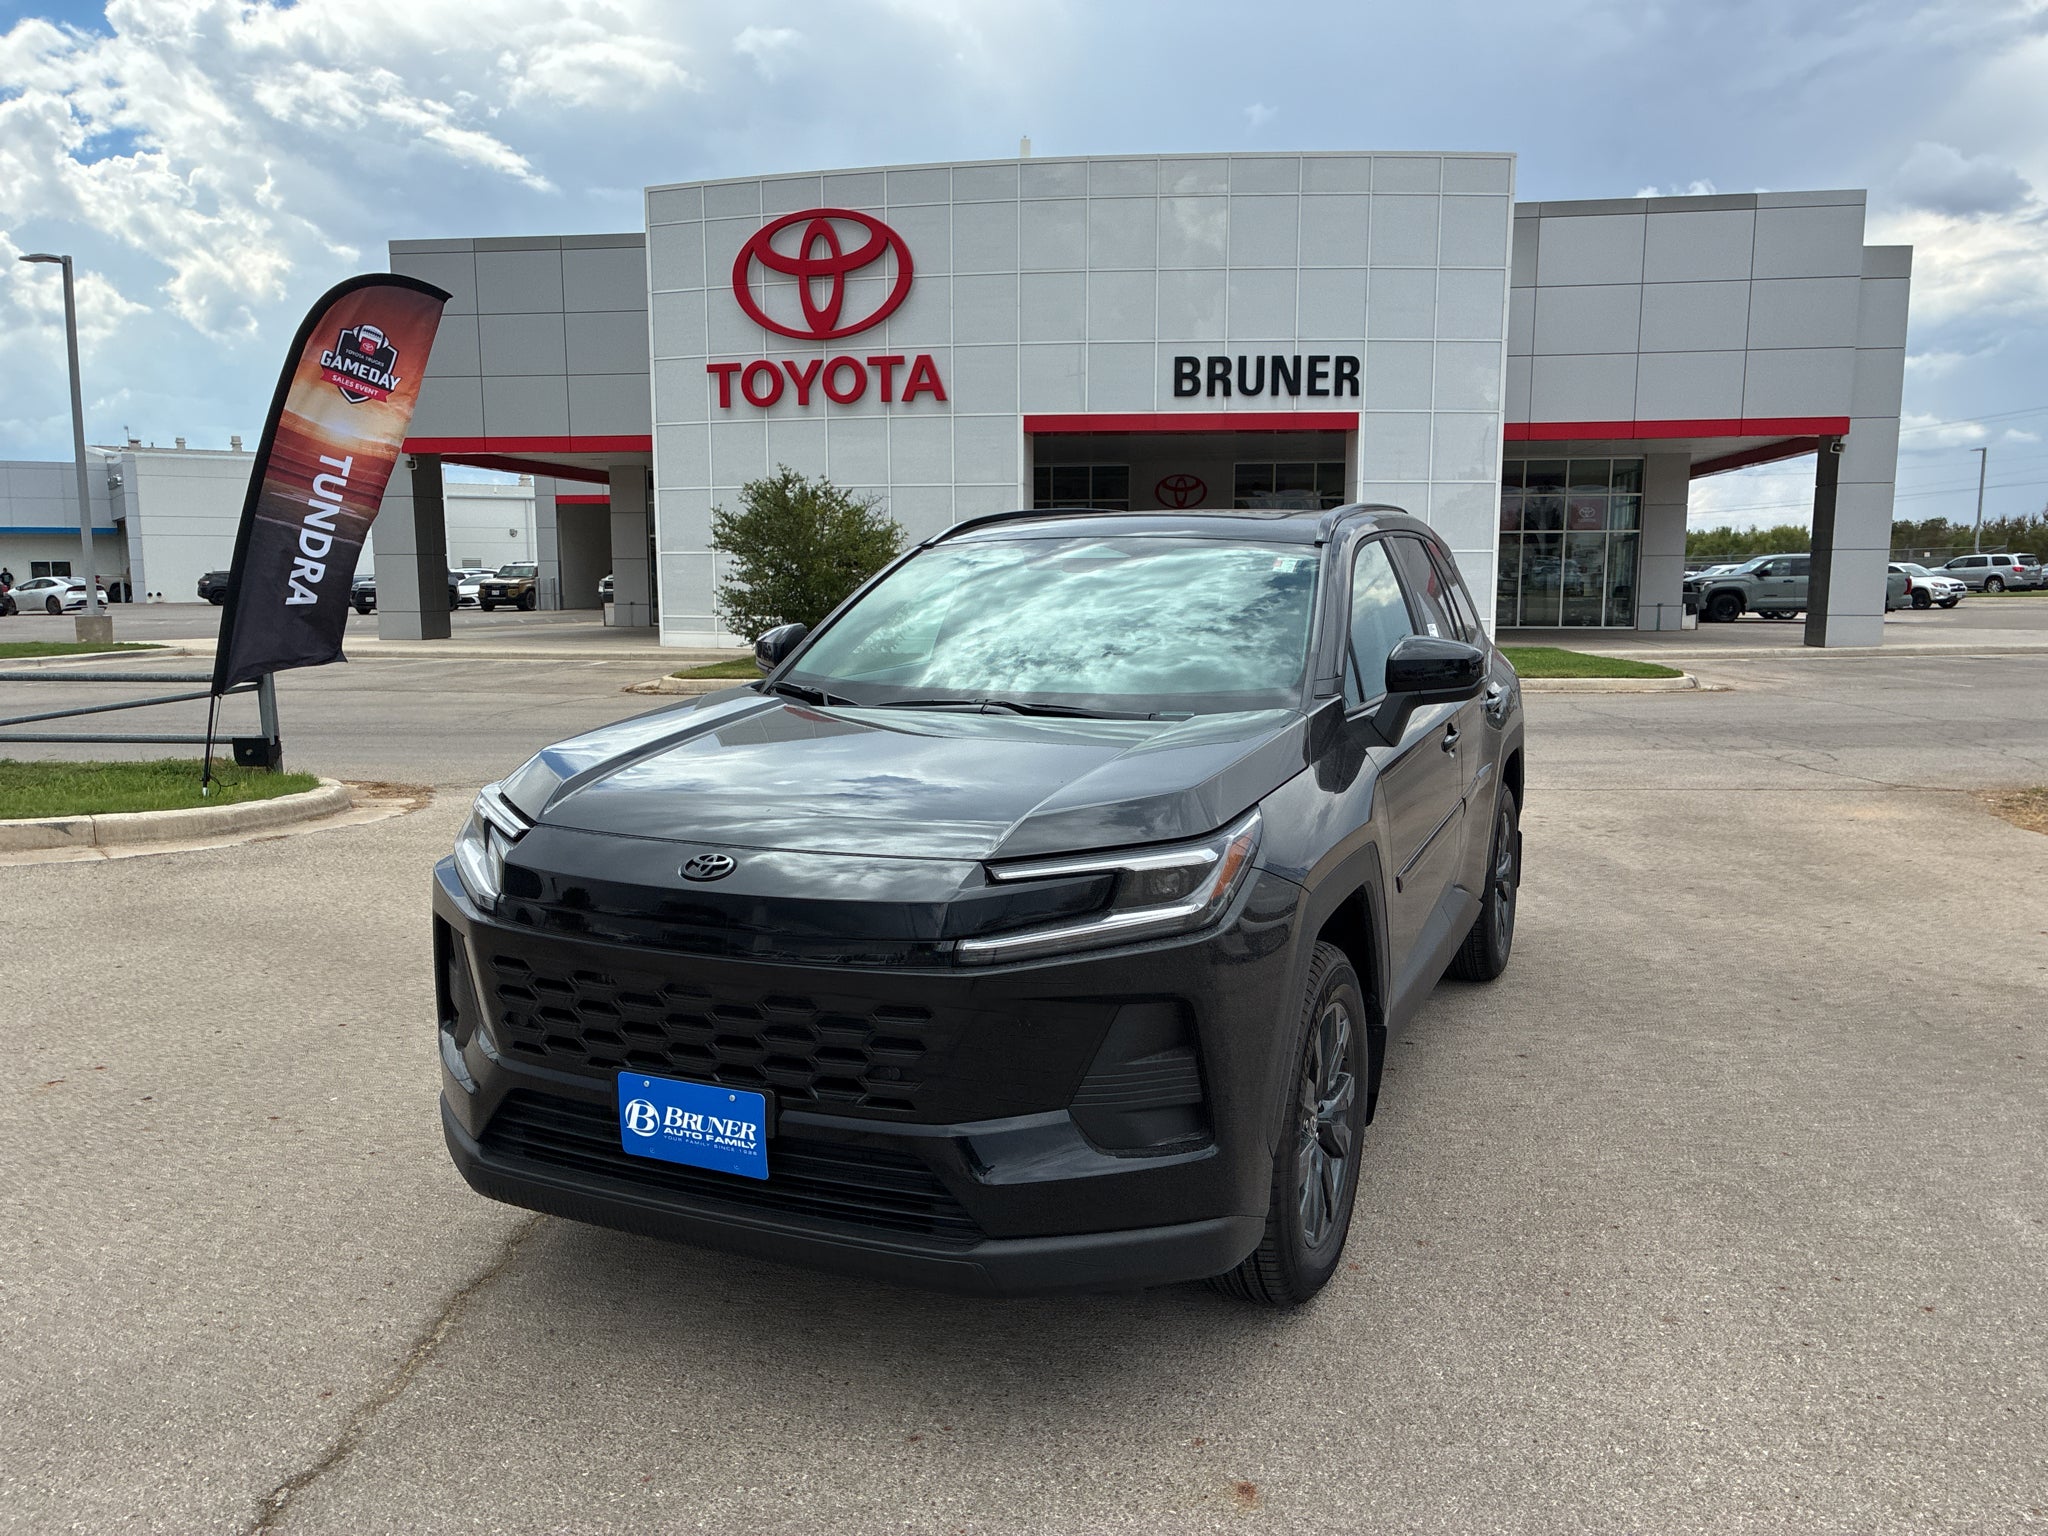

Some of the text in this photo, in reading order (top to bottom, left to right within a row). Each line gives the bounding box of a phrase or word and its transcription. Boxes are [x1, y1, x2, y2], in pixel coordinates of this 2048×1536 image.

[320, 350, 402, 391] GAMEDAY
[345, 348, 385, 367] TOYOTA TRUCKS
[332, 374, 379, 396] SALES EVENT
[706, 354, 948, 408] TOYOTA
[1174, 355, 1360, 397] BRUNER
[285, 454, 353, 606] TUNDRA
[663, 1106, 757, 1141] BRUNER
[664, 1127, 757, 1150] AUTO FAMILY
[685, 1139, 710, 1147] FAMILY
[713, 1144, 735, 1152] SINCE
